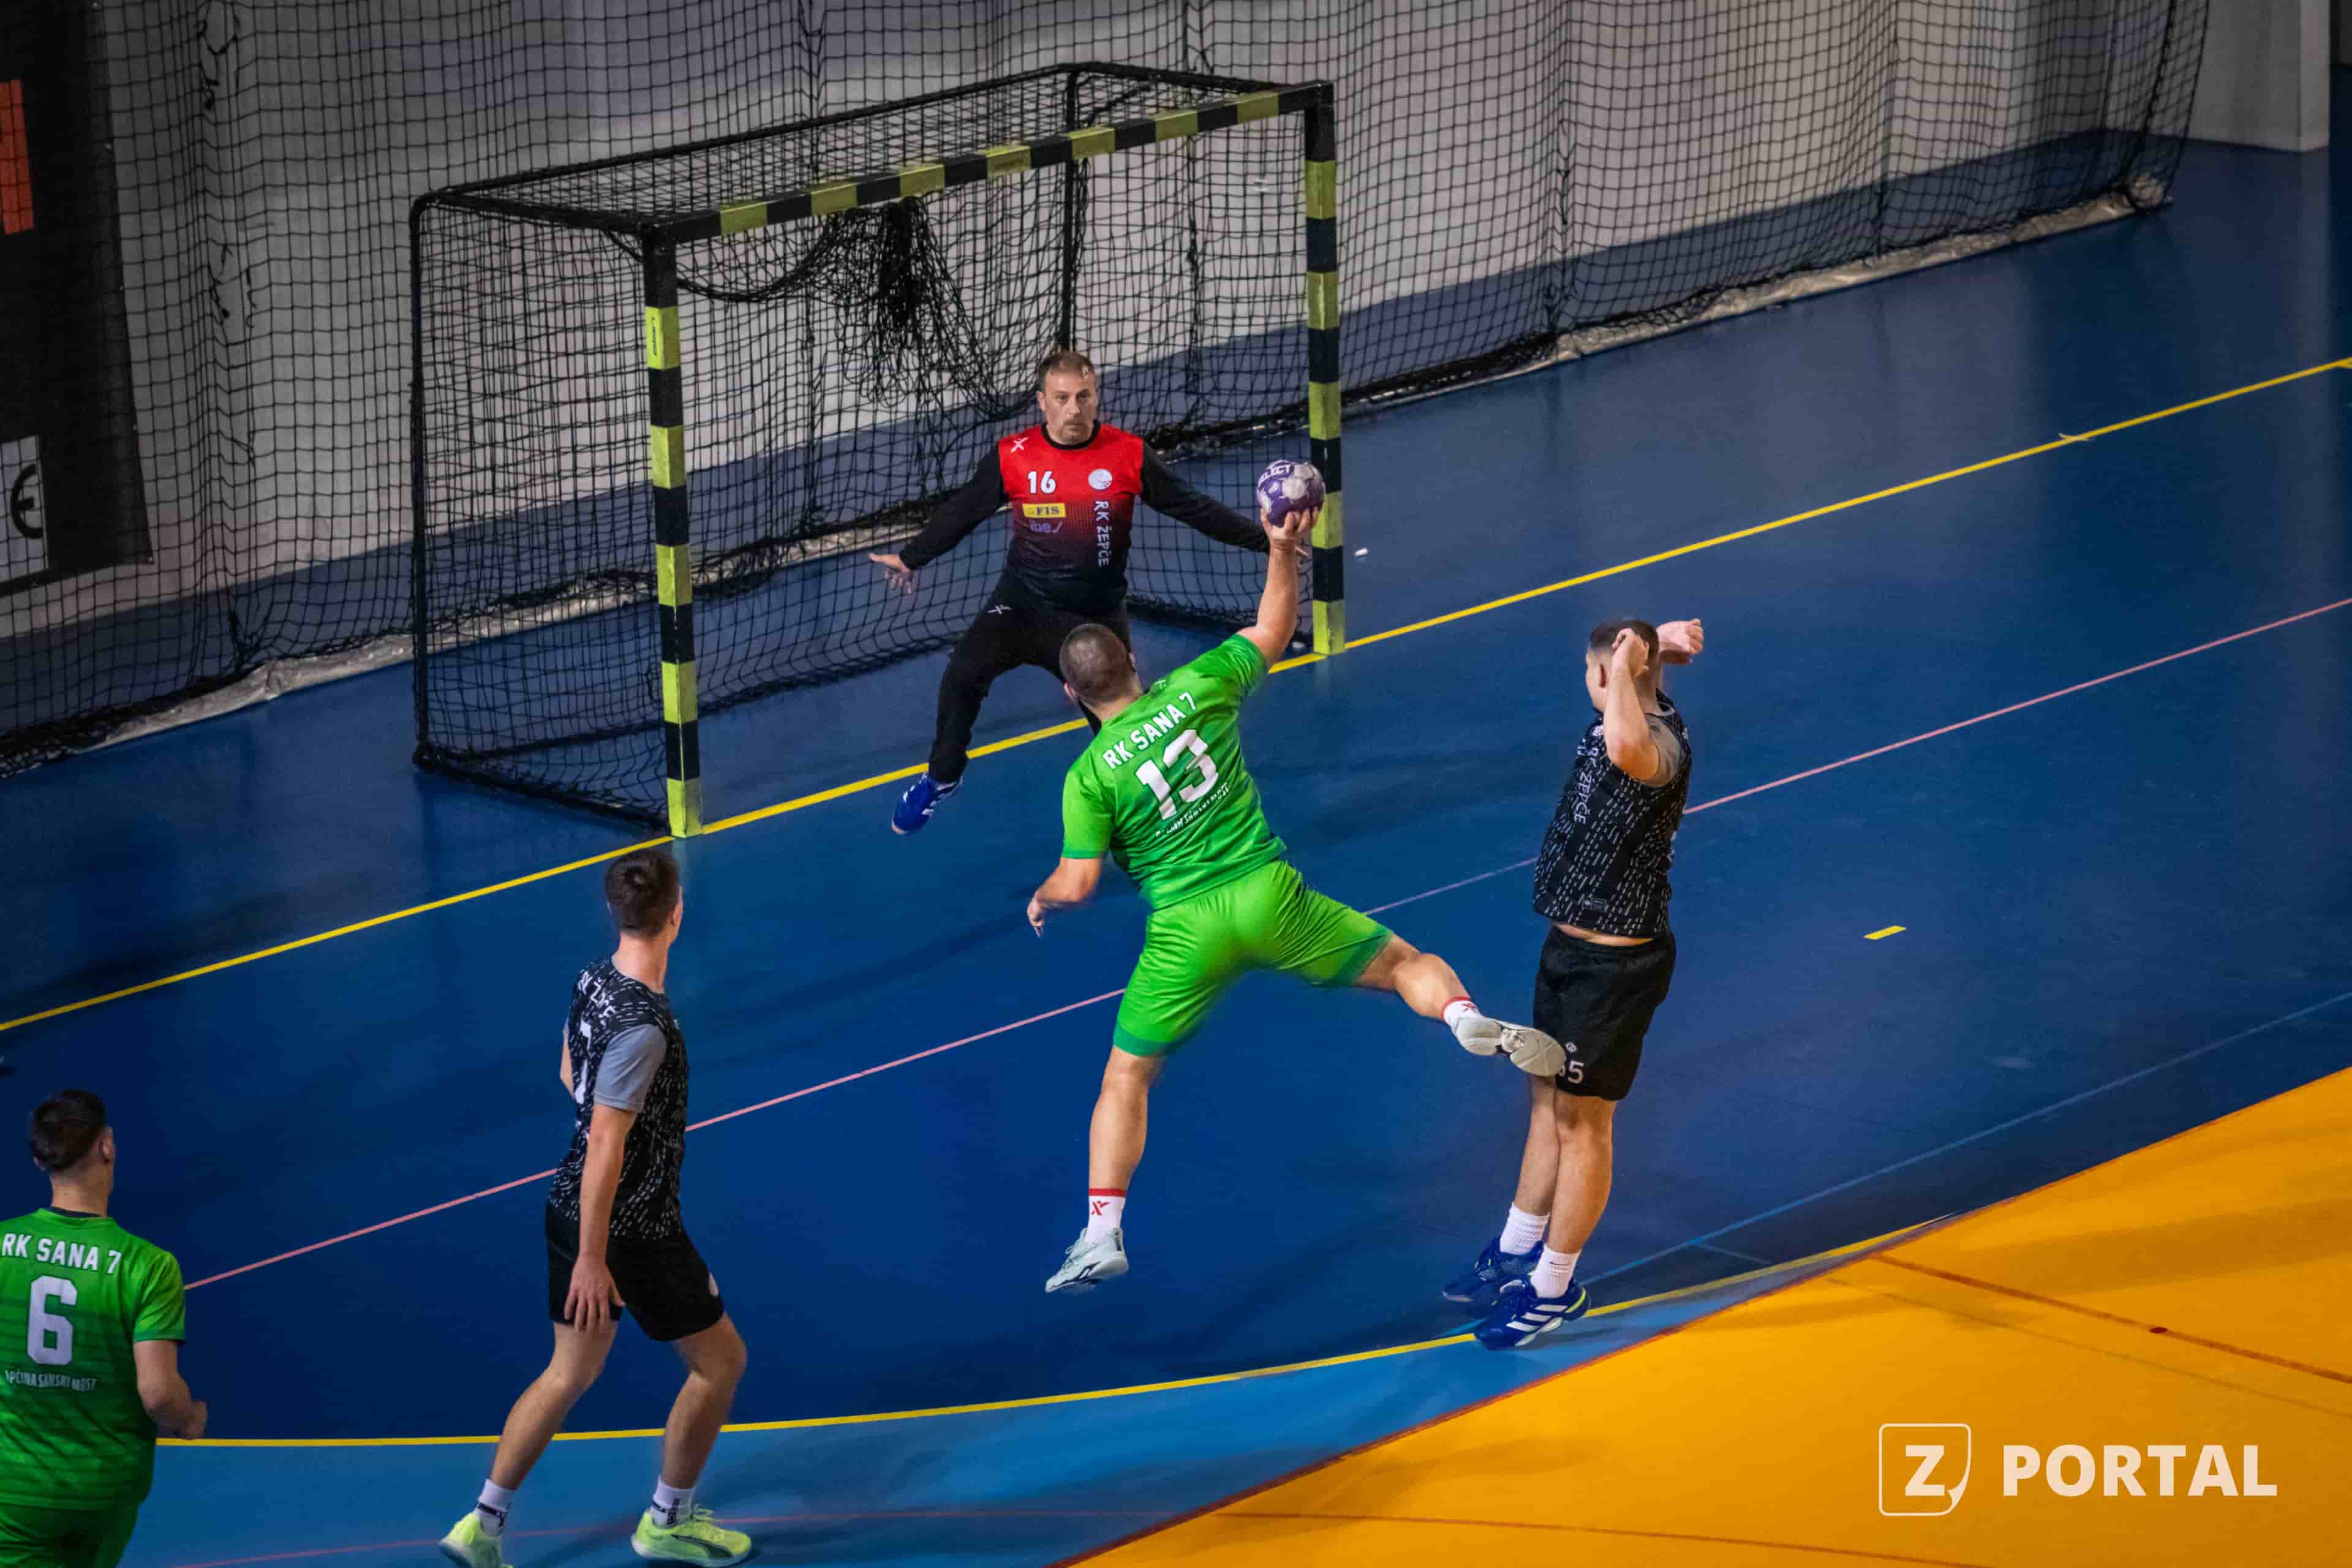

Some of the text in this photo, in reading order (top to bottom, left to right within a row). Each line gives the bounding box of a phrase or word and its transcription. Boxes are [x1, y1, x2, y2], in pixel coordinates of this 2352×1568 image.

[1028, 471, 1056, 494] 16
[1094, 500, 1109, 521] RK
[1102, 692, 1196, 769] RK SANA 7
[1136, 729, 1219, 820] 13
[1, 1233, 122, 1274] RK SANA 7
[27, 1275, 78, 1366] 6
